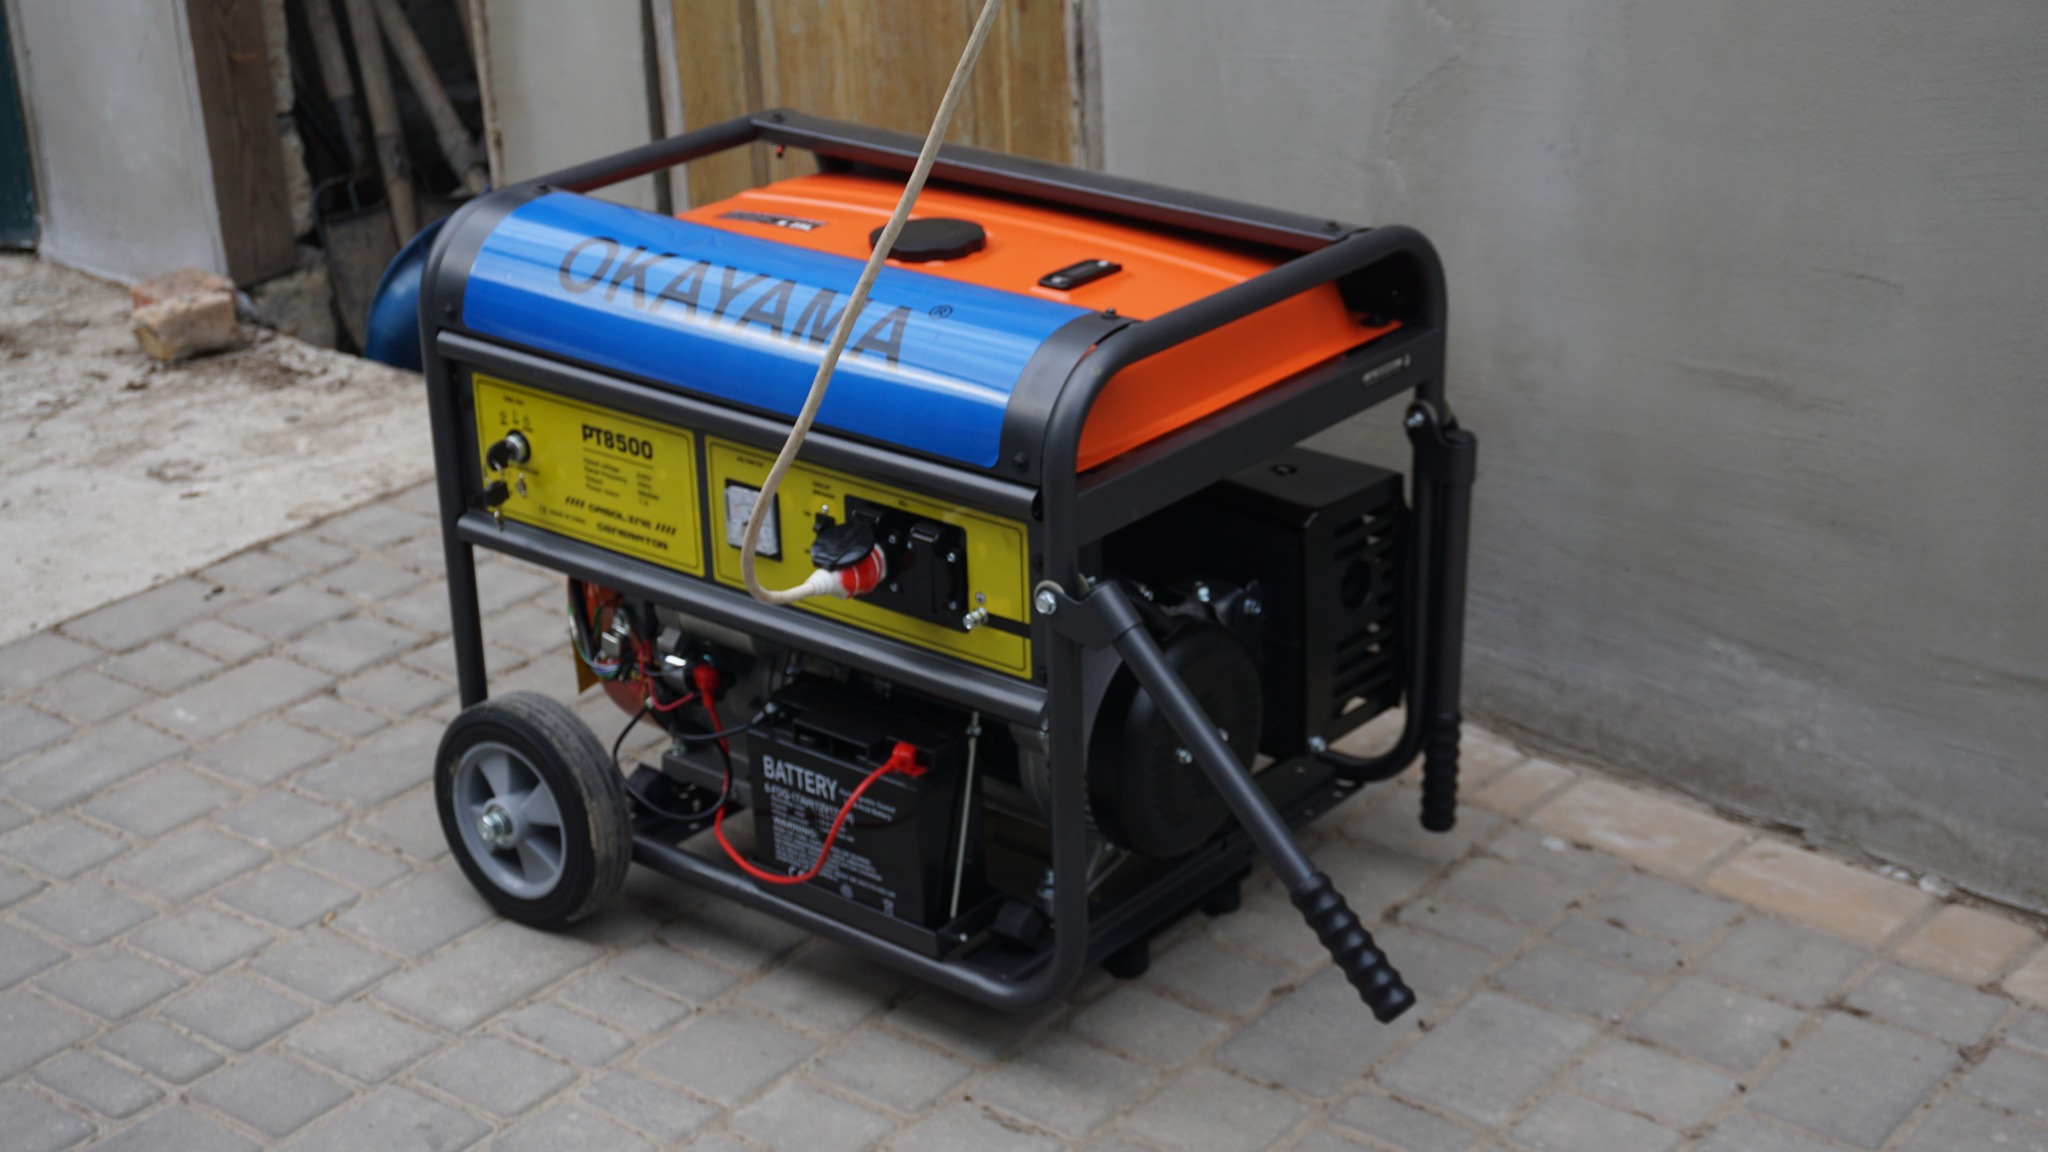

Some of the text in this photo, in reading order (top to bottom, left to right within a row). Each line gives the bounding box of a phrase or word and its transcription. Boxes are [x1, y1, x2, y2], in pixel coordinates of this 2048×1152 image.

[558, 236, 912, 369] OKAYAMA
[581, 423, 654, 460] PT8500
[762, 754, 838, 801] BATTERY
